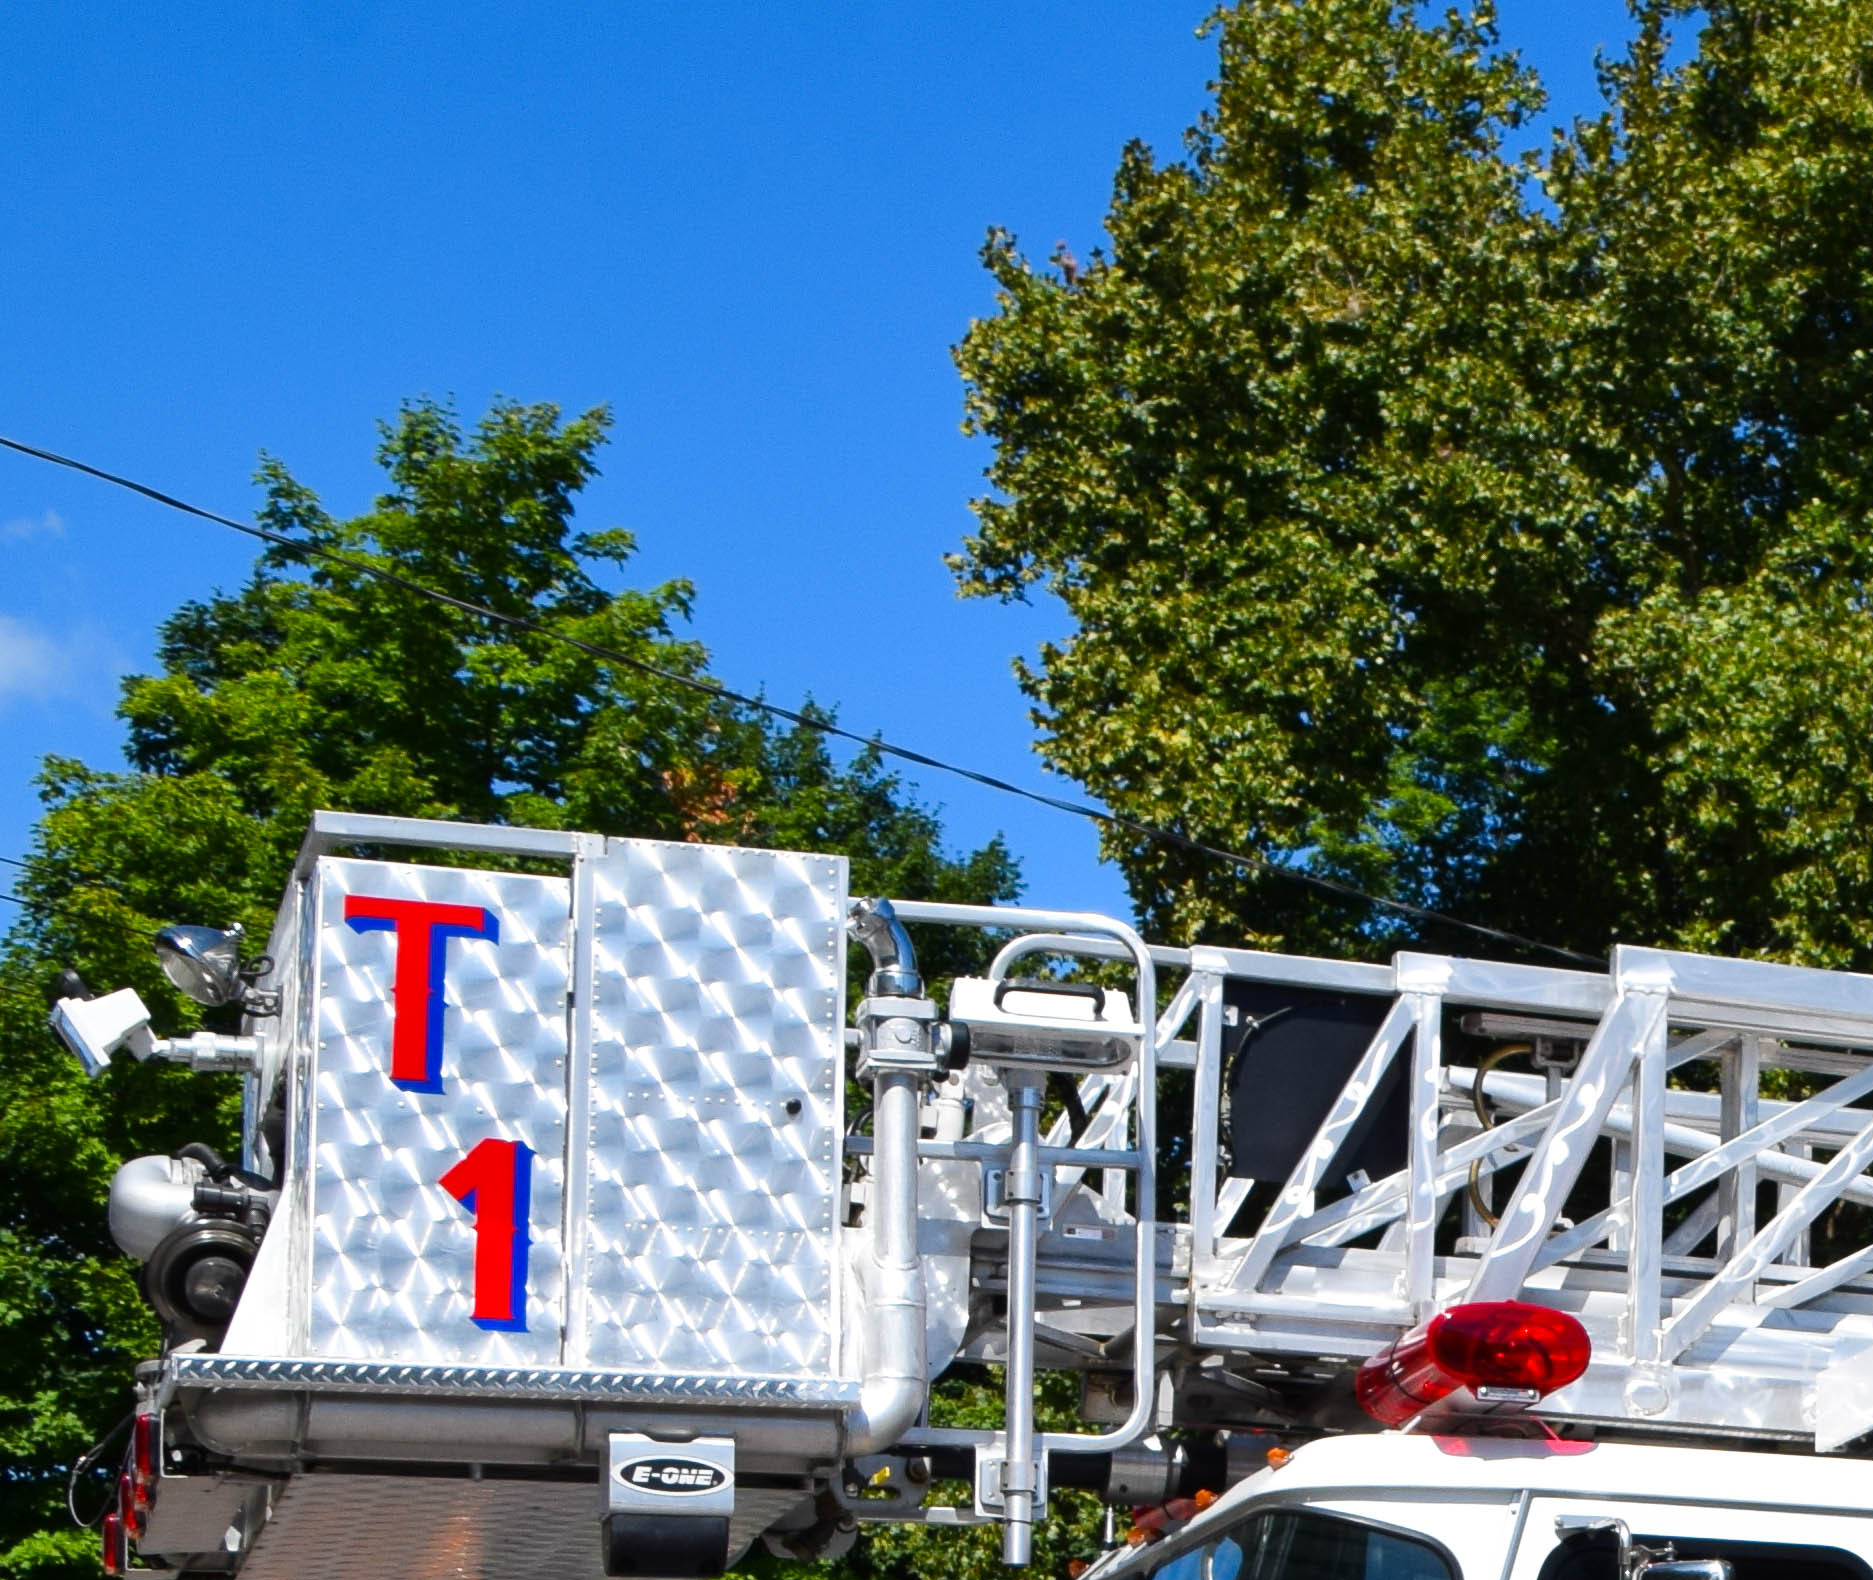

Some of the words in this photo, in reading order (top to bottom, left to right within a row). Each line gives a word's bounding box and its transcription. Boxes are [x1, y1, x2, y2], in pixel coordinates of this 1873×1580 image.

[344, 895, 499, 1095] T
[440, 1137, 536, 1333] 1
[632, 1466, 714, 1485] E-ONE
